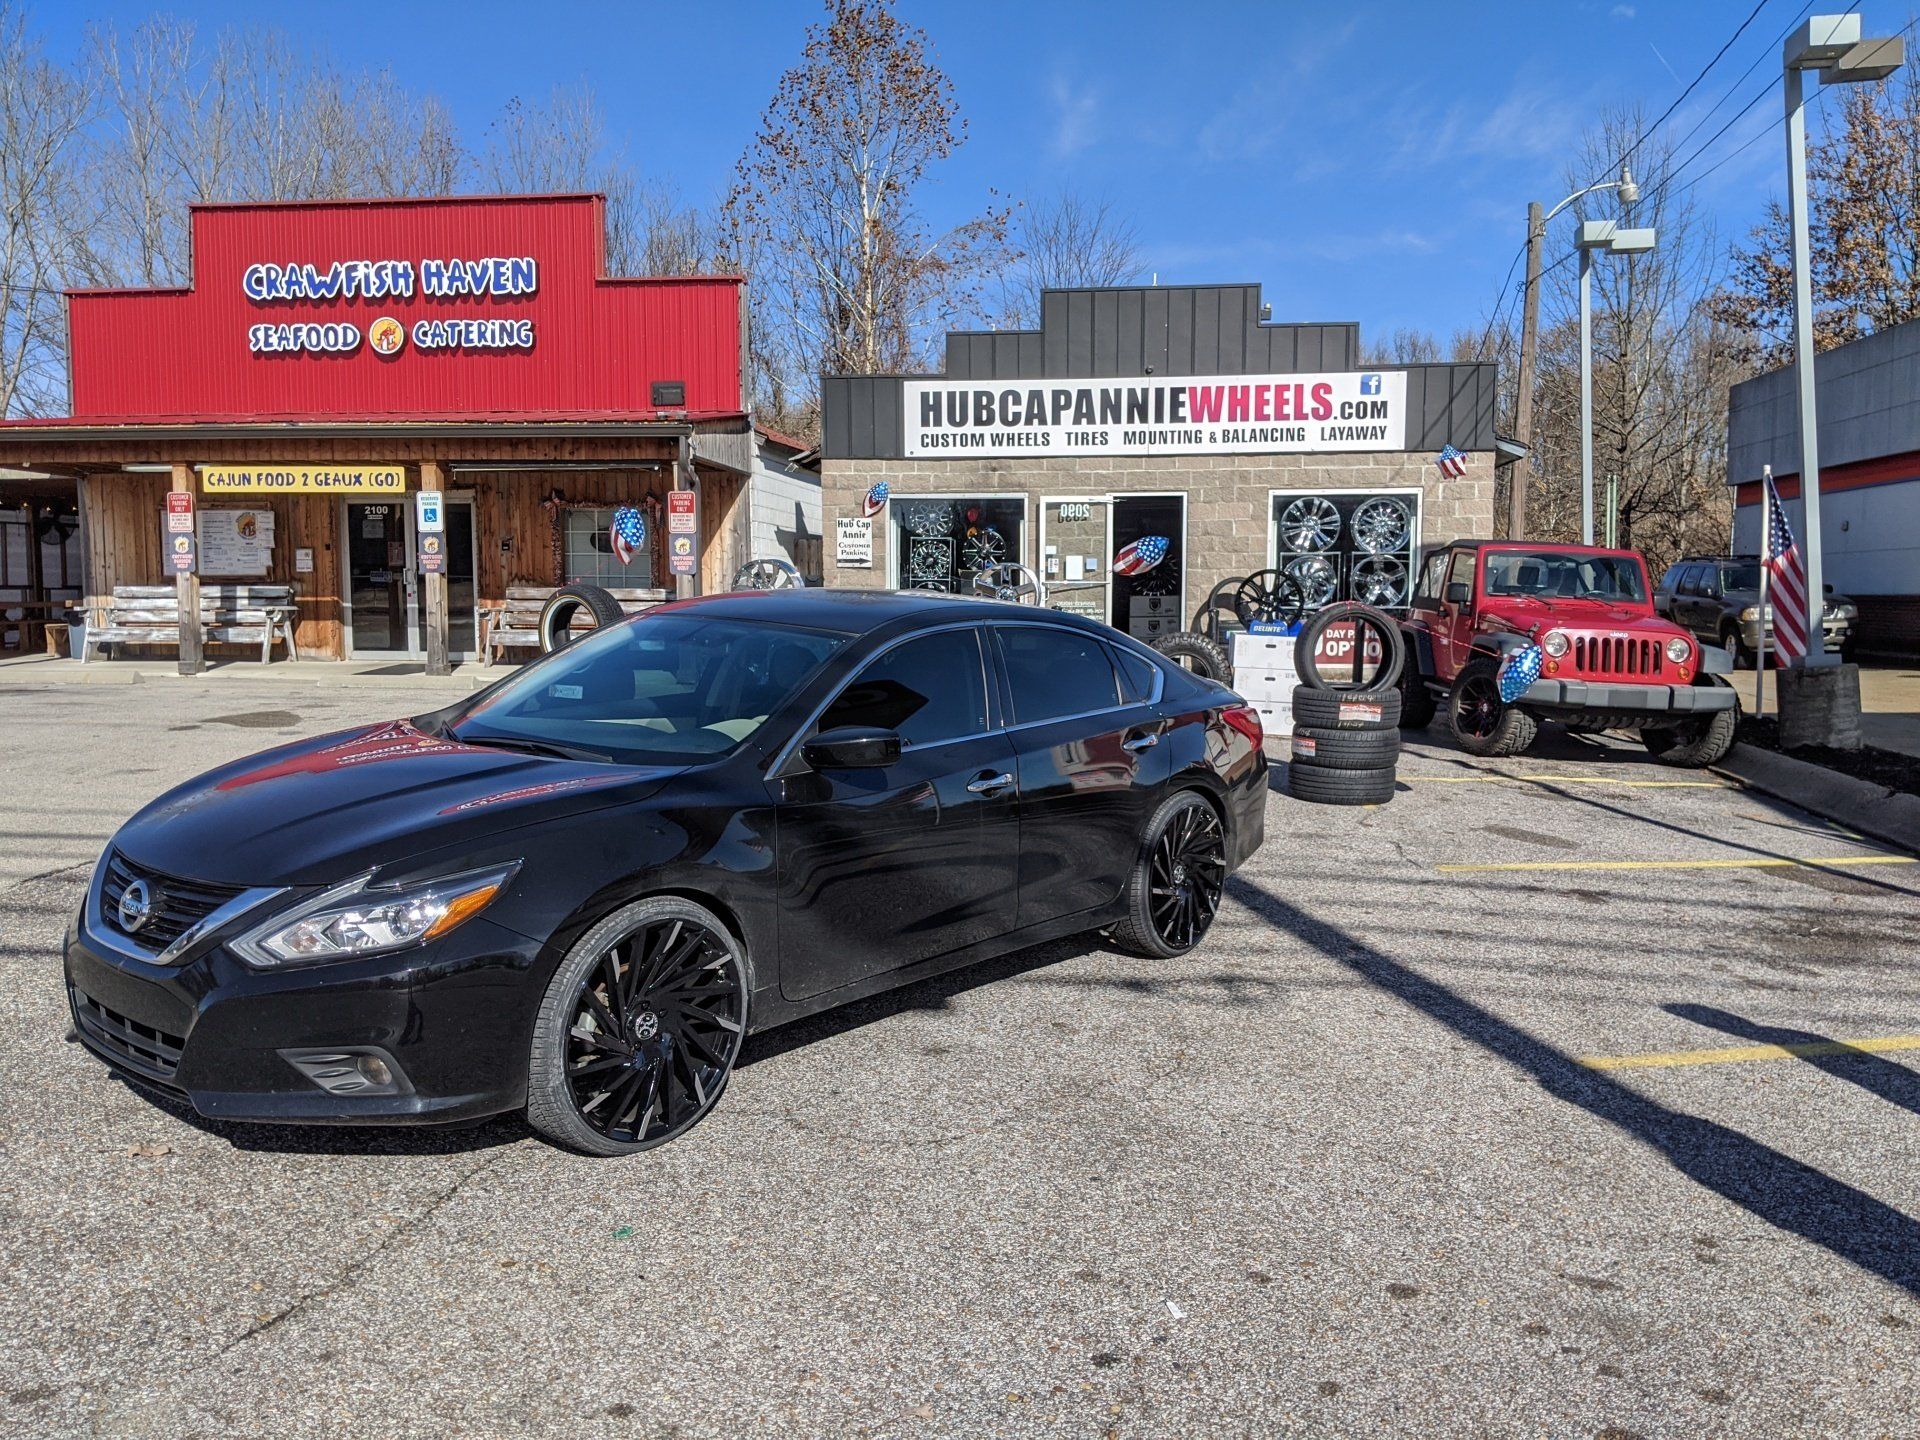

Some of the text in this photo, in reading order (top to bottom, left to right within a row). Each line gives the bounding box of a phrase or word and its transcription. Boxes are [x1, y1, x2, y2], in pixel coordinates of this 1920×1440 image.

[243, 257, 537, 299] CRAWFISH HAVEN
[249, 319, 532, 351] SEAFOOD CATERING
[920, 425, 1387, 448] CUSTOM WHEELS TIRES MOUNTING & BALANCING LAYAWAY
[207, 472, 400, 487] CAJUN FOOD 2 GEAUX (GO)
[364, 506, 388, 514] 2100
[838, 520, 871, 530] Hub Cap
[842, 530, 866, 539] Annie
[1326, 629, 1346, 638] DAY
[1610, 631, 1628, 639] Jeep
[1325, 640, 1382, 657] OPIO
